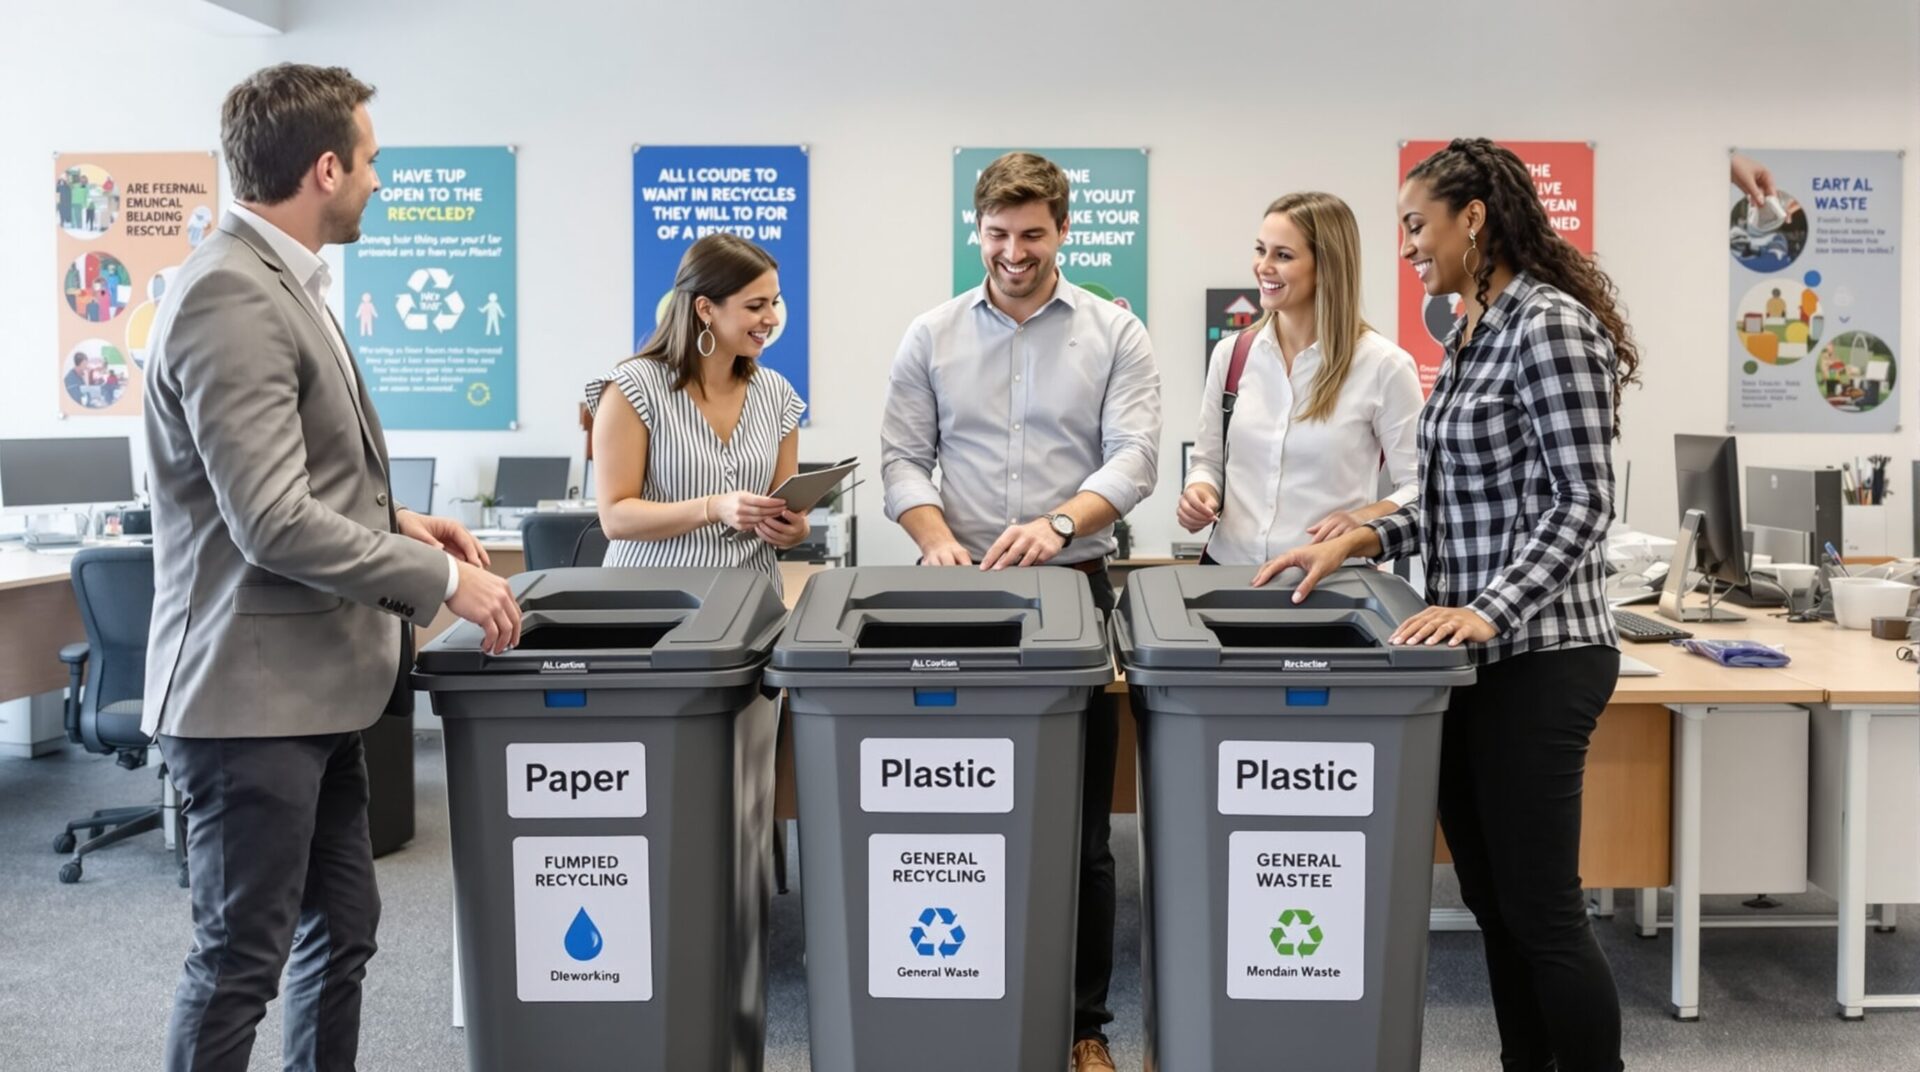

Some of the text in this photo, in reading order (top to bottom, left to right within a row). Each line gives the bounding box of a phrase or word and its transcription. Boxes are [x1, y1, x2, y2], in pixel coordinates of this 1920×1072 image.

[393, 169, 466, 183] HAVE TUP
[658, 168, 686, 182] ALL
[697, 168, 751, 182] COUDE
[755, 168, 778, 182] TO
[126, 183, 149, 195] ARE
[1812, 177, 1873, 191] EART AL
[380, 187, 483, 202] OPEN TO THE
[642, 187, 796, 202] WANT IN RECYCCLES
[1083, 190, 1136, 204] YOUUT
[126, 197, 183, 209] EMUNCAL
[1815, 197, 1867, 210] WASTE
[126, 211, 183, 222] BELADING
[388, 206, 475, 221] RECYCLED?
[652, 206, 788, 220] THEY WILL TO FOR
[1096, 210, 1140, 224] YOUR
[126, 225, 181, 236] RESCYLAT
[657, 226, 679, 240] OF
[682, 226, 695, 240] A
[759, 226, 782, 240] UN
[1070, 252, 1112, 267] FOUR
[881, 758, 996, 788] Plastic
[1236, 759, 1358, 791] Plastic
[526, 763, 630, 799] Paper
[545, 856, 619, 869] FUMPIED
[900, 852, 978, 865] GENERAL
[1257, 853, 1341, 868] GENERAL
[535, 873, 628, 886] RECYCLING
[893, 870, 986, 883] RECYCLING
[1256, 873, 1333, 888] WASTEE
[897, 967, 979, 978] General Waste
[1301, 966, 1341, 978] Waste
